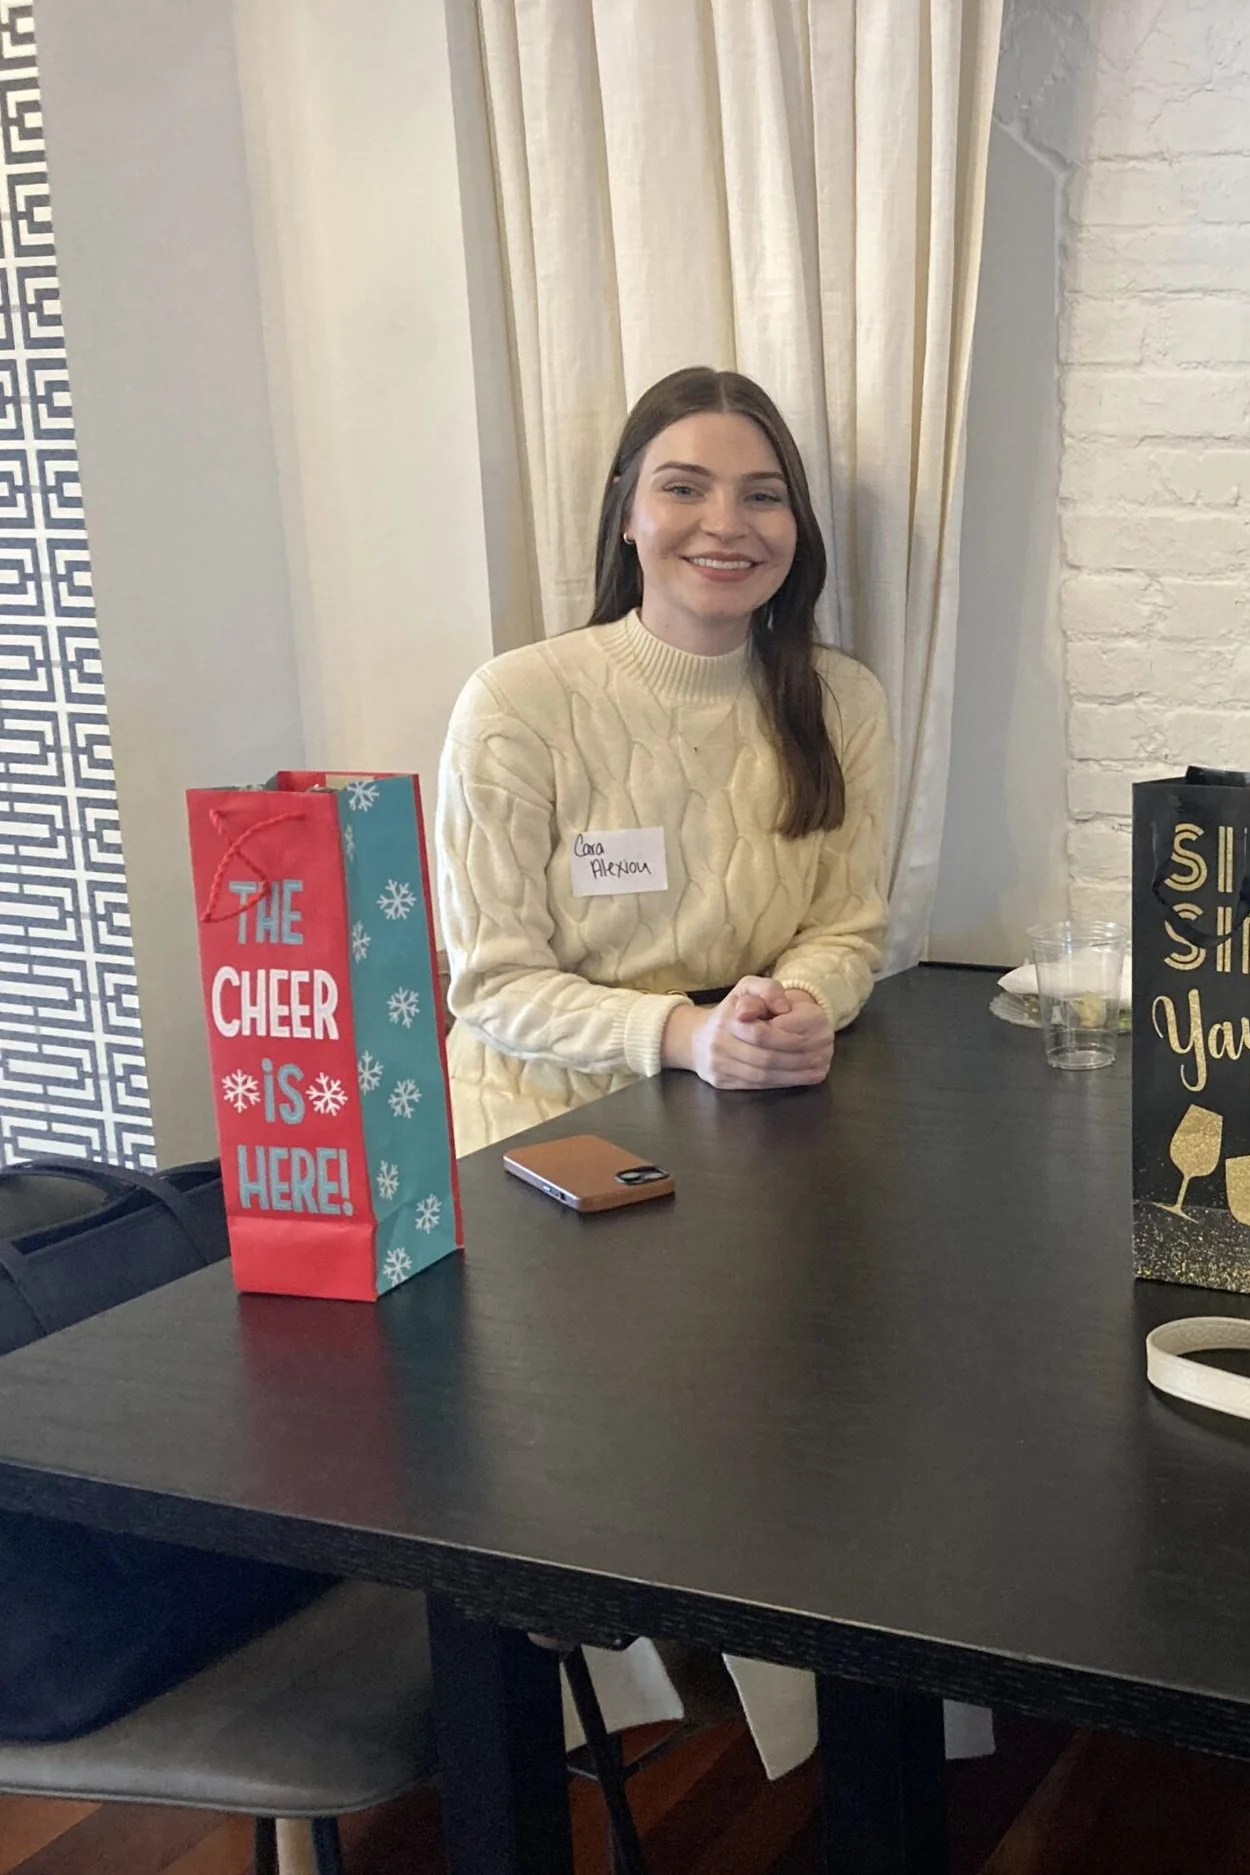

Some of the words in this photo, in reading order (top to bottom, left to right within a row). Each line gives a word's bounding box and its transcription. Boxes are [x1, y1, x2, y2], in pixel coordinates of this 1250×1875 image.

[573, 833, 605, 858] Cara
[589, 858, 652, 880] Alexiou
[228, 879, 304, 945] THE
[211, 965, 340, 1040] CHEER
[236, 1144, 354, 1217] HERE!
